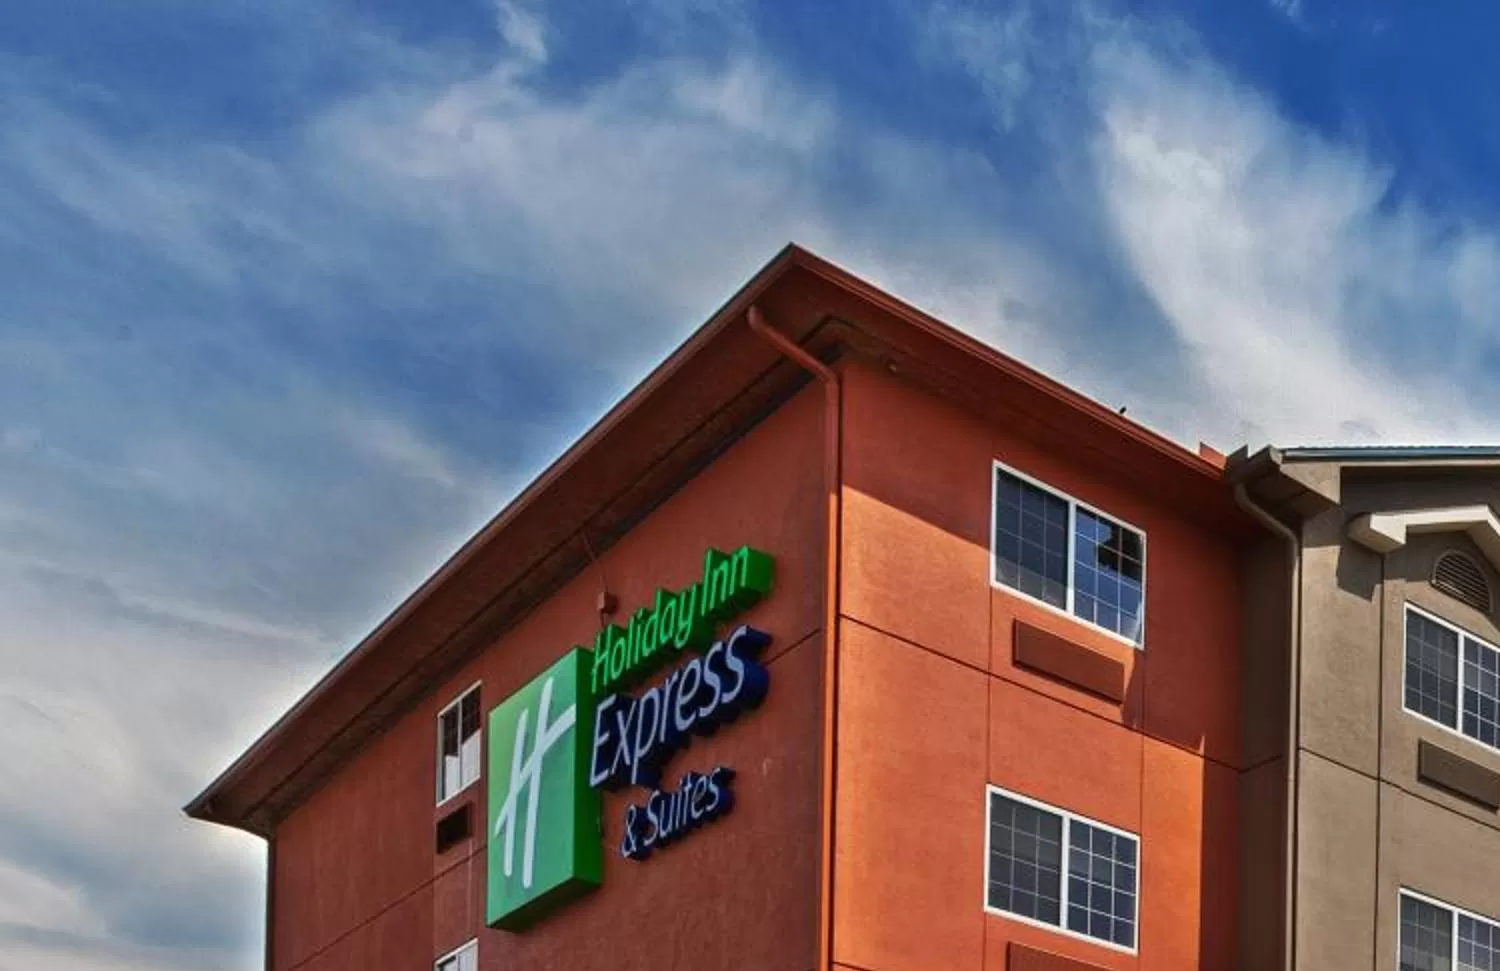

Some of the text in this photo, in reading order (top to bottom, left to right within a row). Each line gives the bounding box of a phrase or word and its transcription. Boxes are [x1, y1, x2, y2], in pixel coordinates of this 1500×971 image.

[591, 544, 750, 695] Holiday Inn
[589, 624, 748, 787] Express
[620, 767, 722, 859] & Suites
